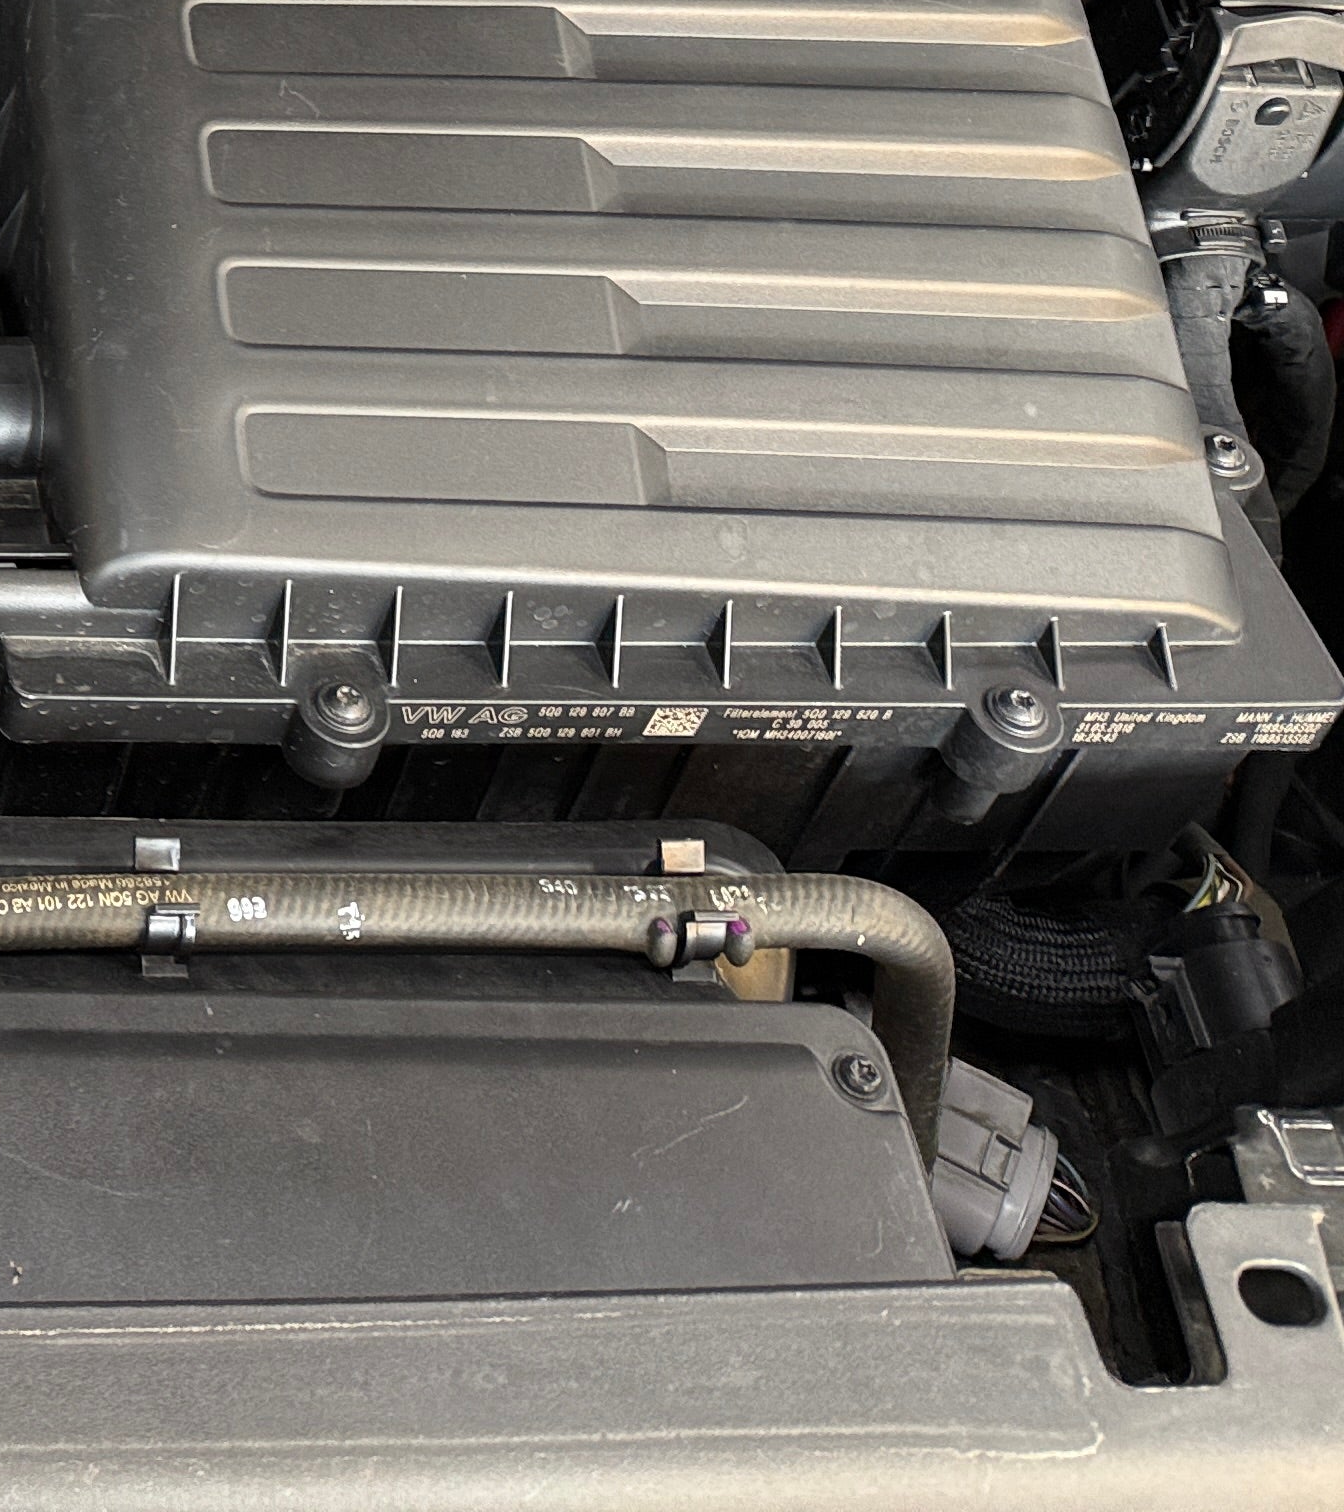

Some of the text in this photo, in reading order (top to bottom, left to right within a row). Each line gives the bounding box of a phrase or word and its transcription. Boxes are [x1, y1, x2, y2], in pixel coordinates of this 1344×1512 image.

[401, 706, 466, 725] VW
[467, 706, 529, 725] AG
[38, 895, 62, 911] 101
[67, 892, 94, 909] 122
[99, 890, 133, 907] 5QN
[136, 889, 158, 905] AG
